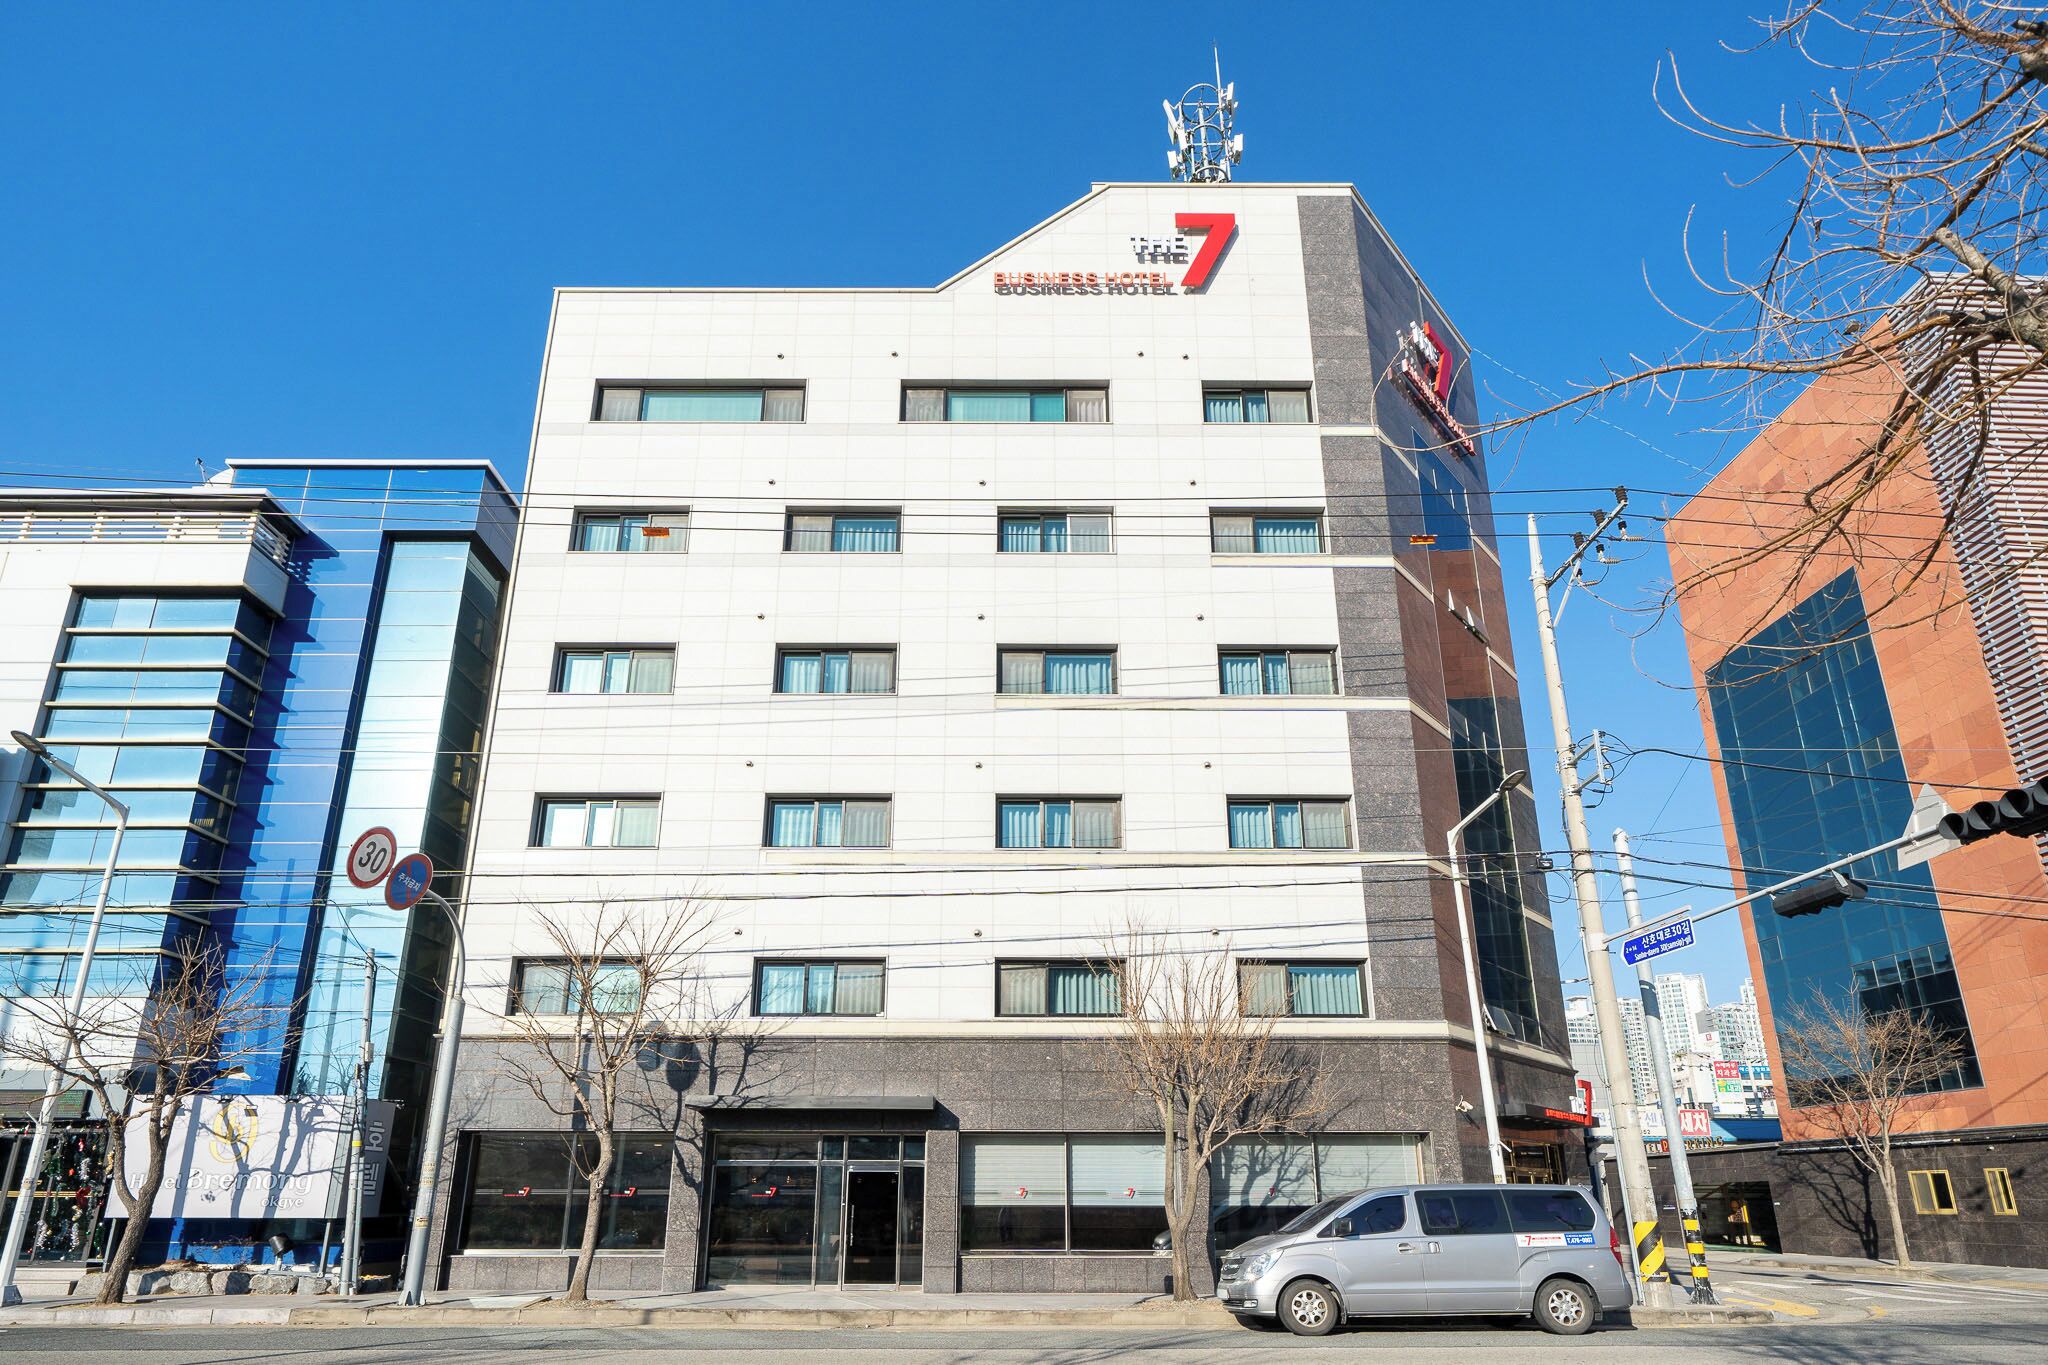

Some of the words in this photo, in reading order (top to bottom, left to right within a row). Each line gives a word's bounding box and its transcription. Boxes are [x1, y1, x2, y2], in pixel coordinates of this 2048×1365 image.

[1175, 213, 1235, 286] 7
[994, 272, 1097, 287] BUSINESS
[1105, 272, 1174, 287] HOTEL
[358, 841, 387, 873] 30
[398, 872, 422, 891] 주차금지
[1641, 921, 1691, 948] 산호대로30길
[1680, 1112, 1708, 1133] 세차
[1661, 1136, 1724, 1152] PRKING
[129, 1173, 182, 1190] Hel
[188, 1168, 312, 1196] Bremong
[261, 1195, 304, 1210] okgye
